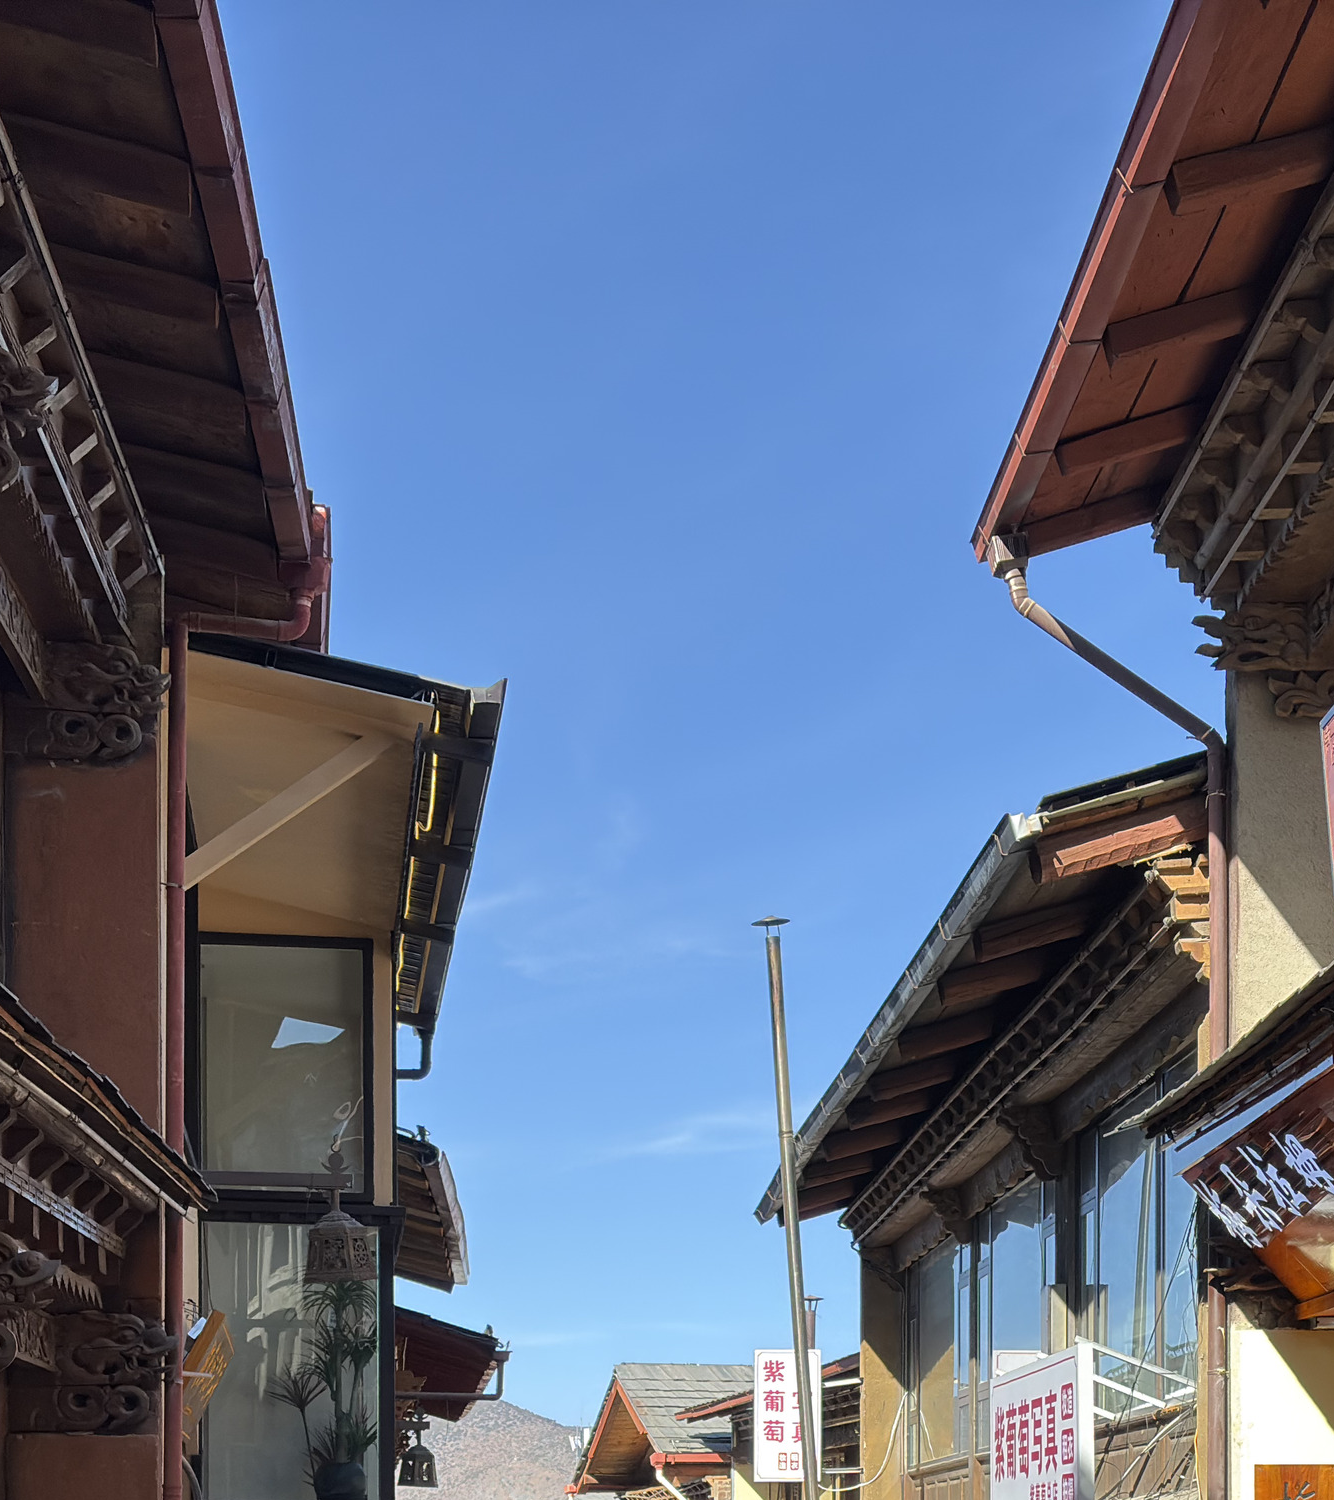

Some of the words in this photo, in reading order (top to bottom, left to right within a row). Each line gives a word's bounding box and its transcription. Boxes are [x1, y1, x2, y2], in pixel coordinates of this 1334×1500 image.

[762, 1359, 786, 1443] 紫葡萄
[994, 1389, 1058, 1483] 紫葡萄写真
